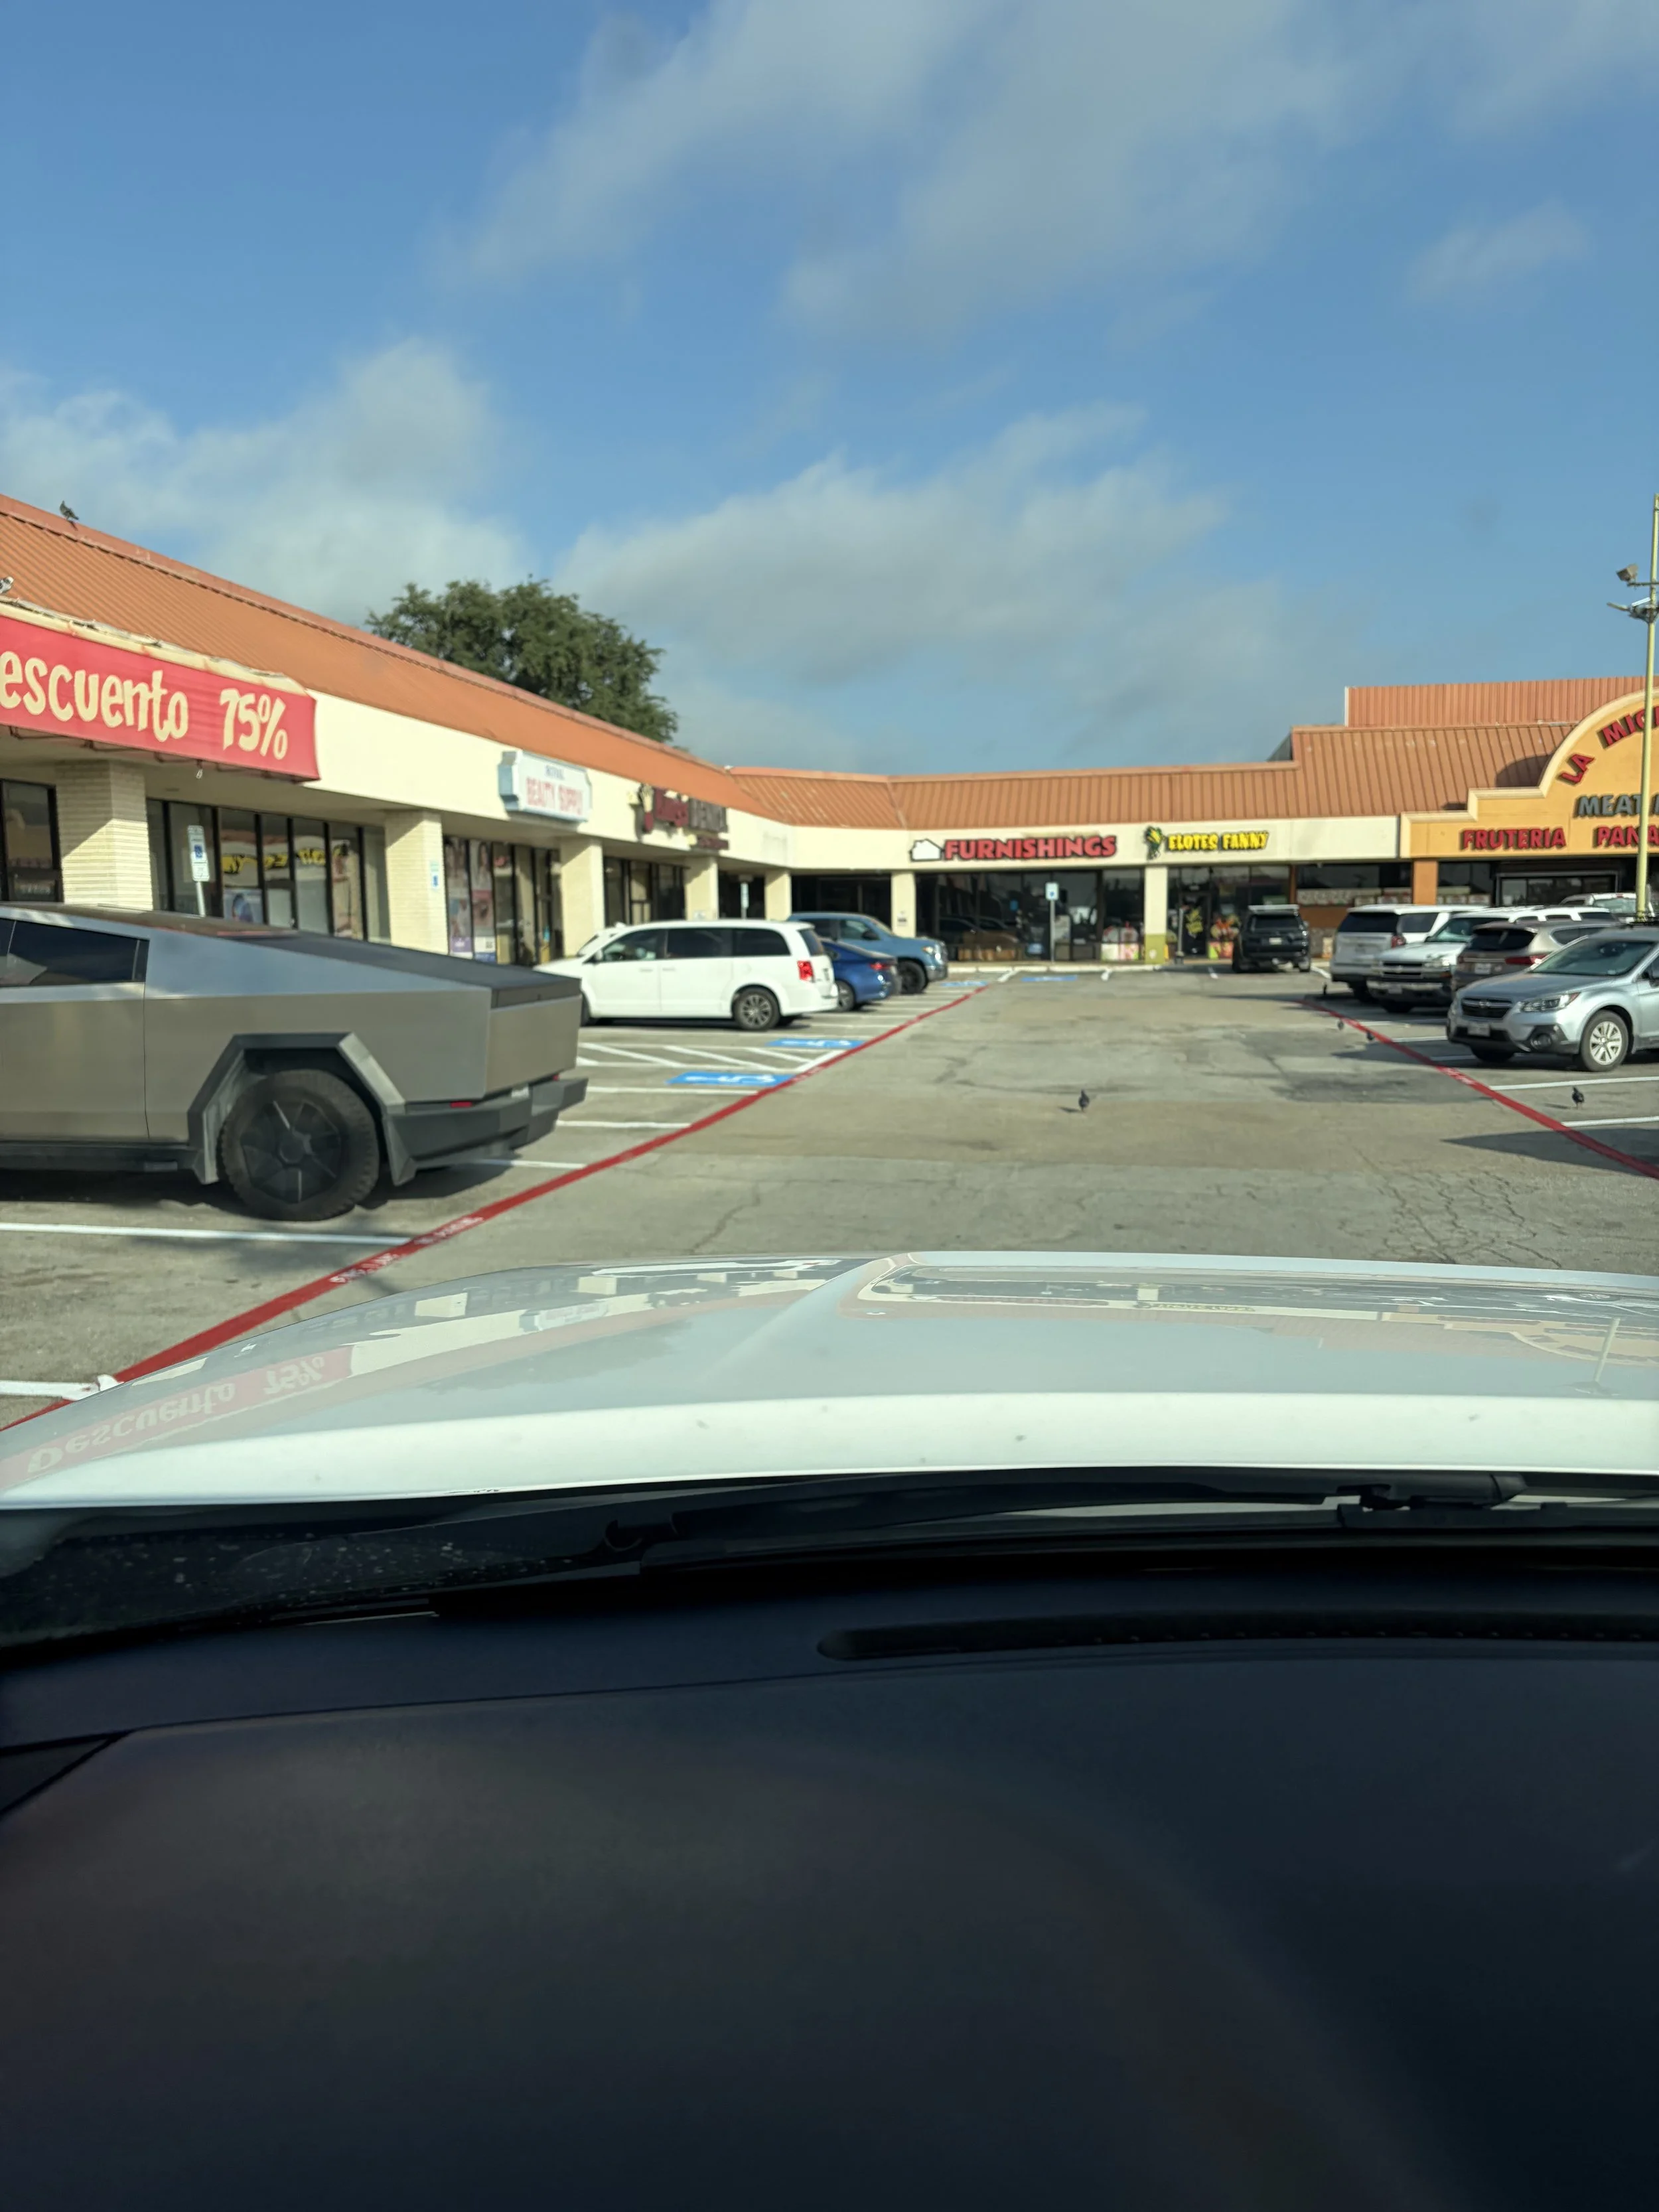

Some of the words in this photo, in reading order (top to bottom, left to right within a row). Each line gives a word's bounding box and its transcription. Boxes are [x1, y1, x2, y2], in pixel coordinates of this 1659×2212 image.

[219, 688, 288, 761] 75%
[1560, 753, 1595, 784] LA
[945, 835, 1116, 860] FURNISHINGS
[1168, 834, 1218, 851] ELOTES
[1222, 831, 1268, 851] FANNY
[1462, 828, 1567, 850] FRUTERIA
